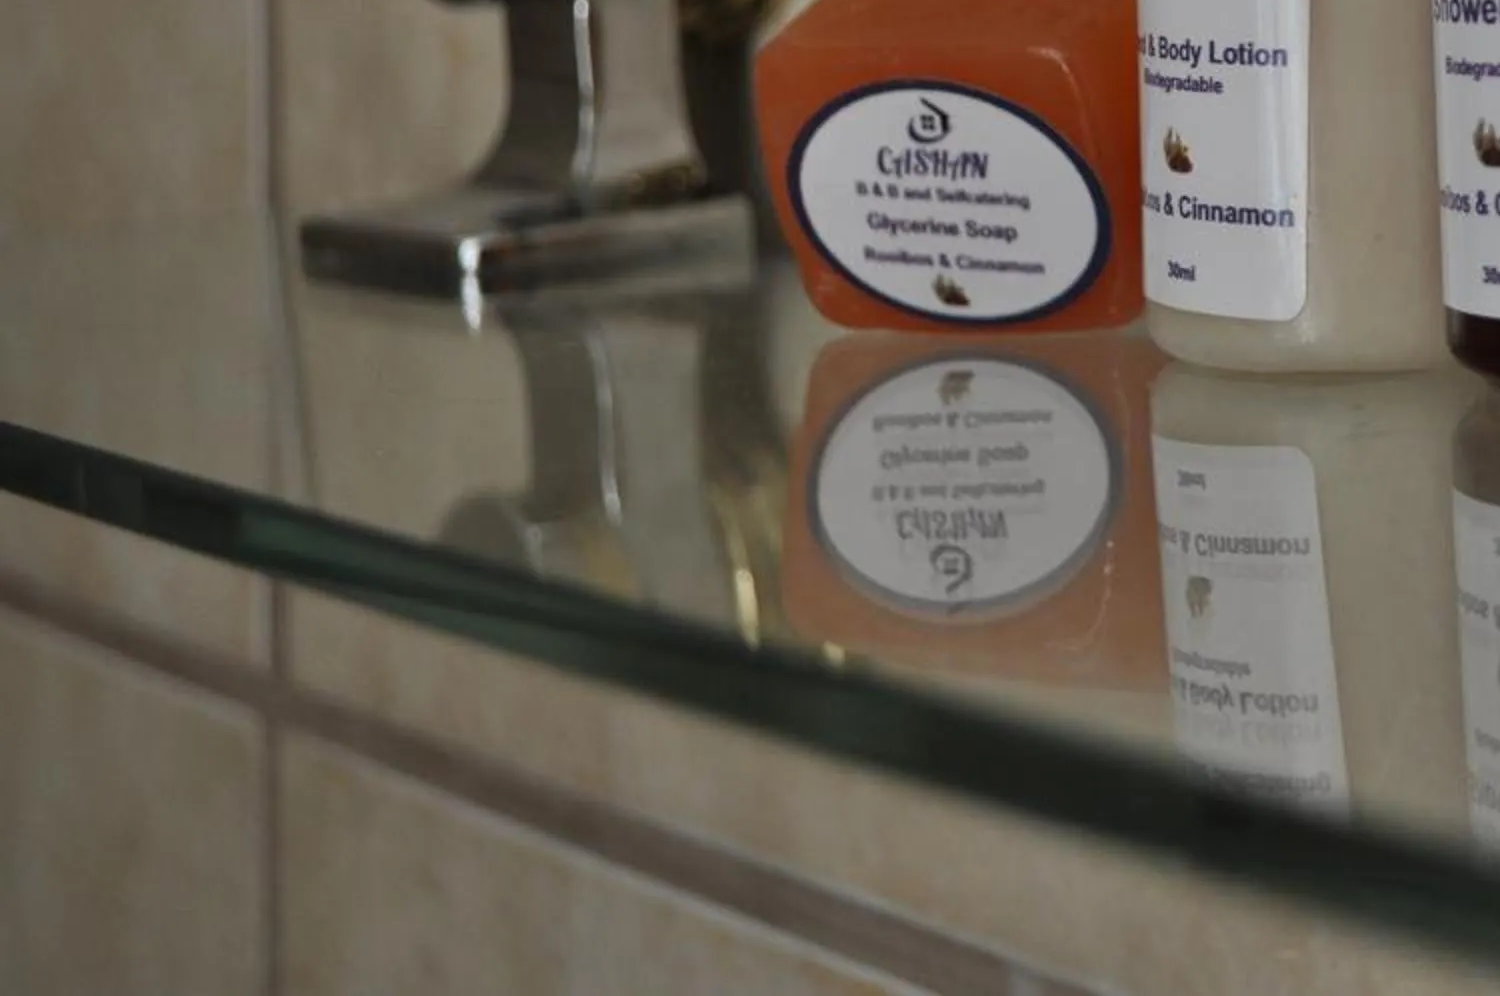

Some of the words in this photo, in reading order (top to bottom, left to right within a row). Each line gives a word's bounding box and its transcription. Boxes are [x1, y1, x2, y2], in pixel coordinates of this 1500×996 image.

[1159, 35, 1202, 69] Body
[1208, 40, 1288, 67] Lotion
[877, 145, 989, 180] CASHAN
[1164, 192, 1174, 216] &
[1179, 195, 1295, 227] Cinnamon
[1475, 190, 1488, 215] &
[867, 212, 959, 237] Glycerine
[965, 220, 1018, 244] Soap
